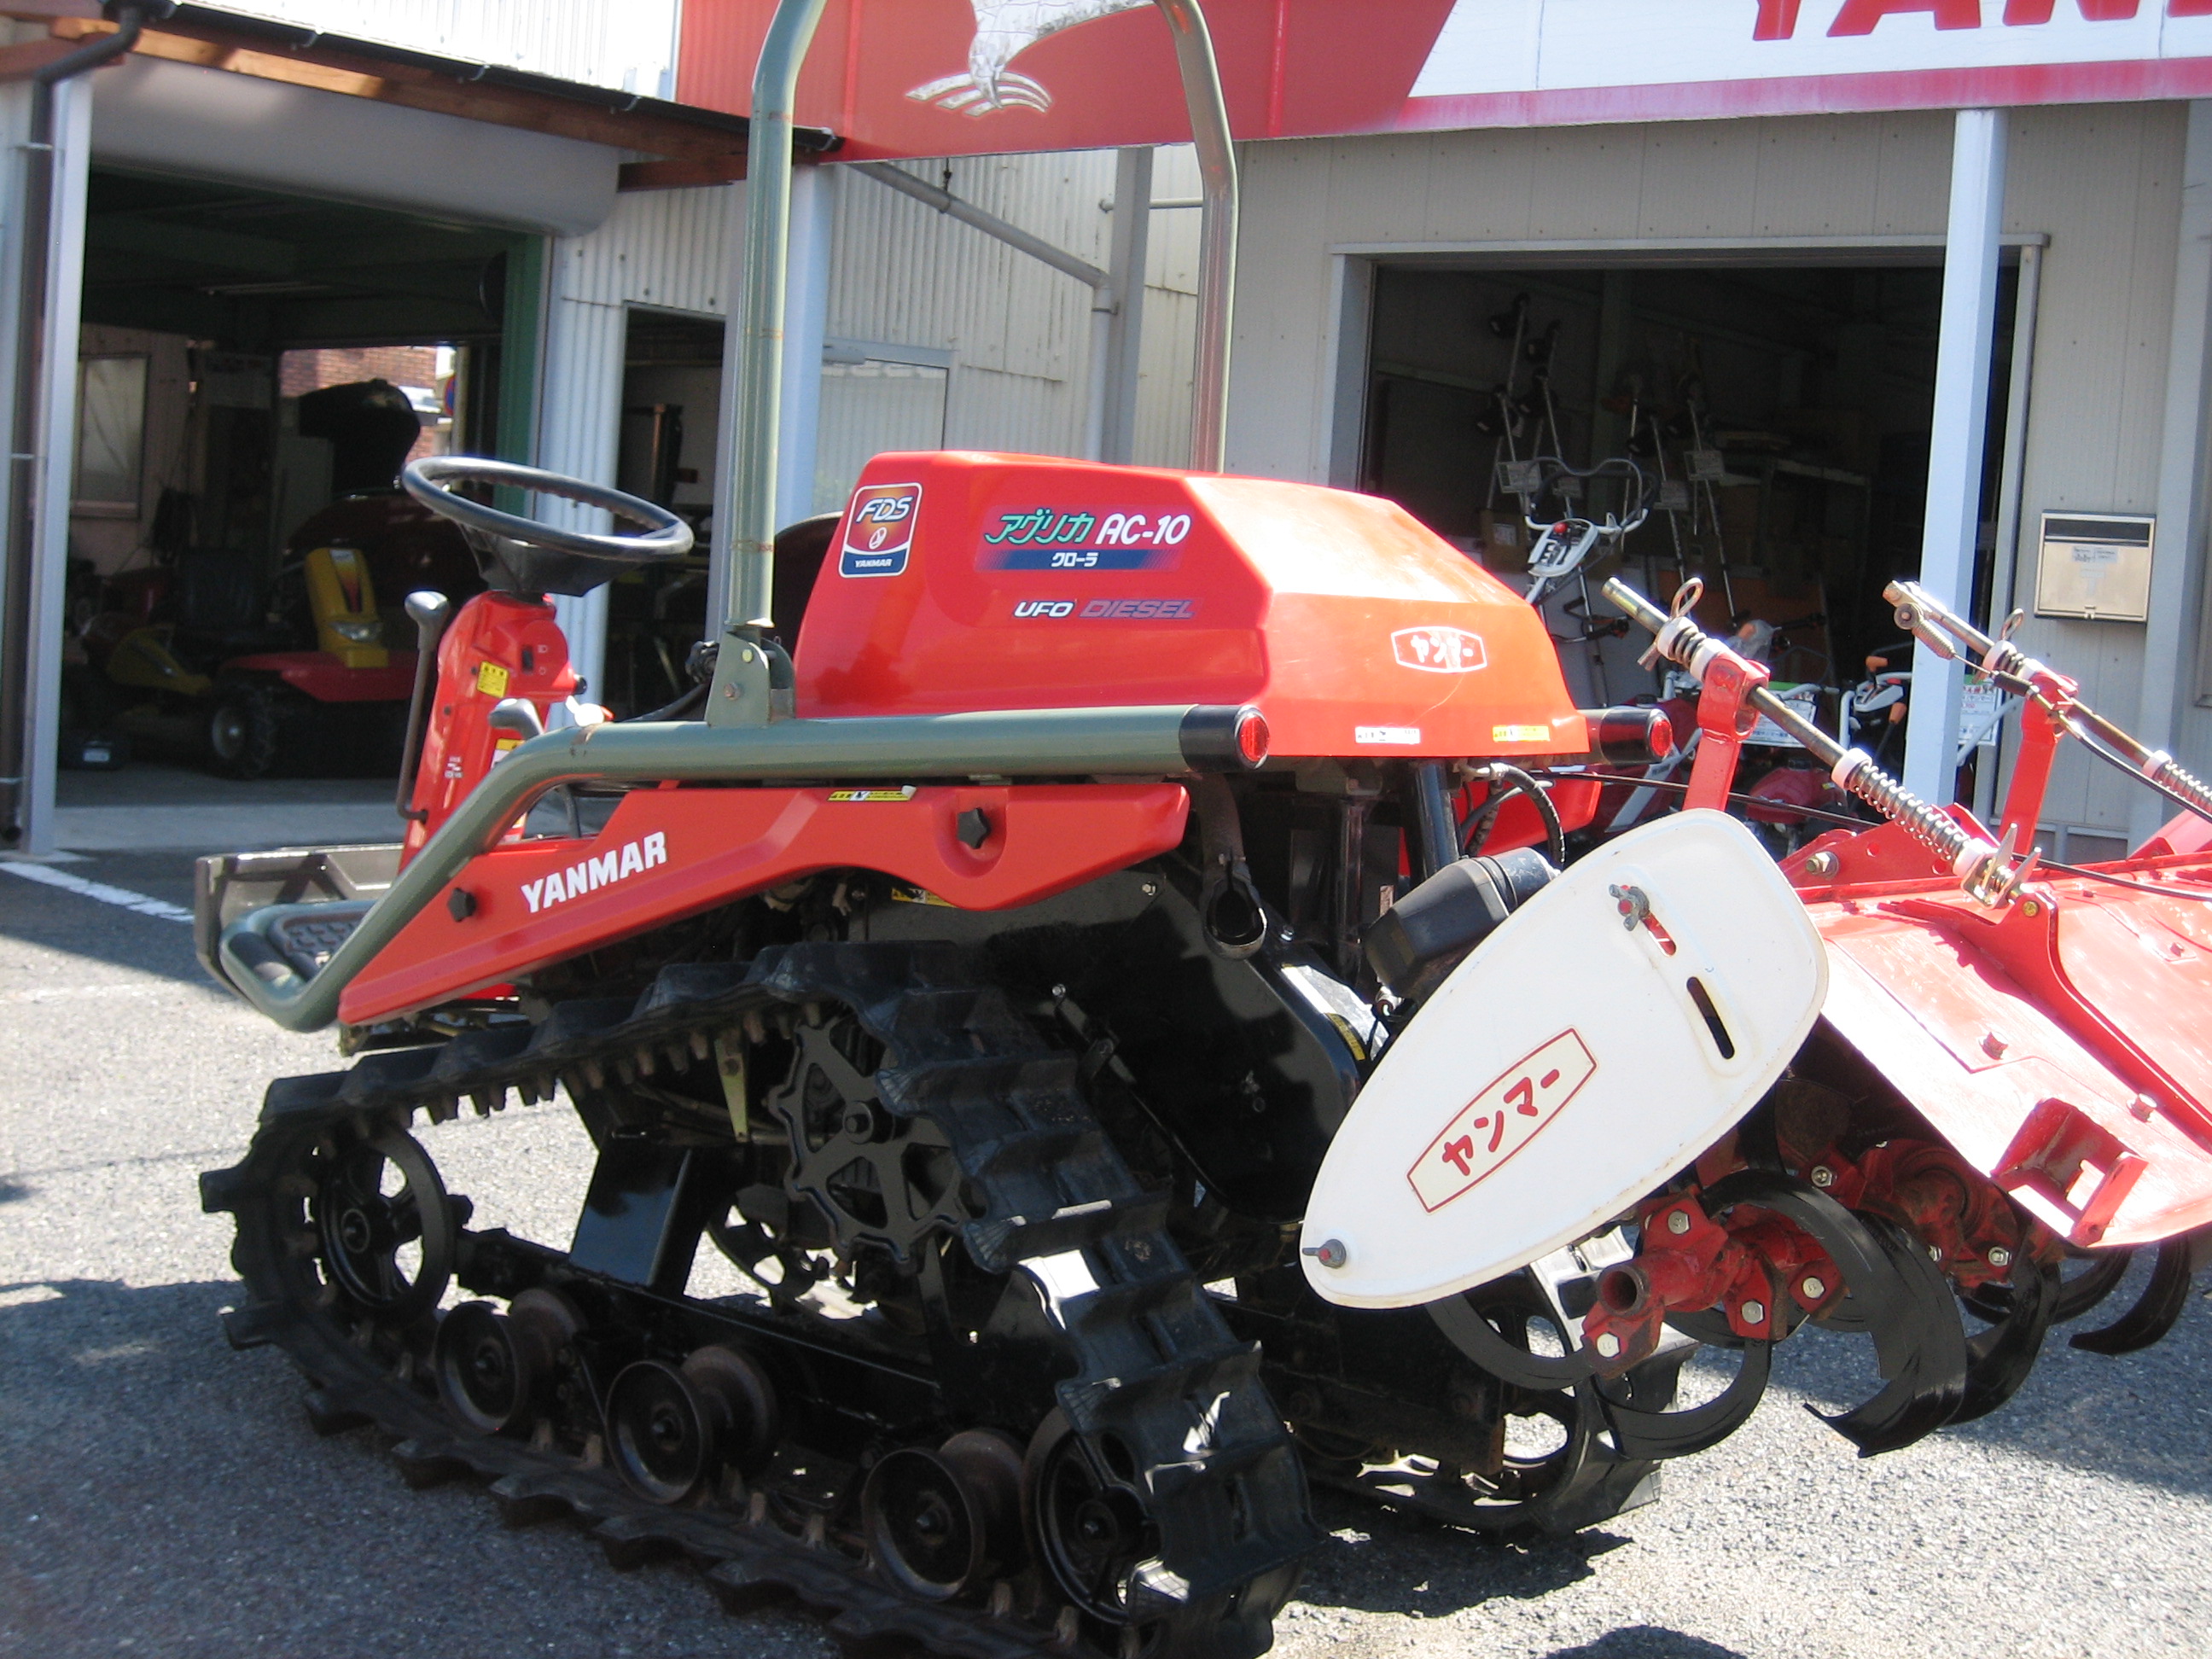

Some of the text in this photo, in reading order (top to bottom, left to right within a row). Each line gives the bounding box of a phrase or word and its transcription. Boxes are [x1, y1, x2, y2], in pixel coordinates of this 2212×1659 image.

[855, 496, 913, 523] FDS
[985, 508, 1191, 544] アグリカ AC-10
[1051, 552, 1099, 568] クローラ
[1014, 600, 1195, 619] UFO DIESEL
[521, 831, 667, 913] YANMAR
[1442, 1068, 1560, 1176] ヤンマー
